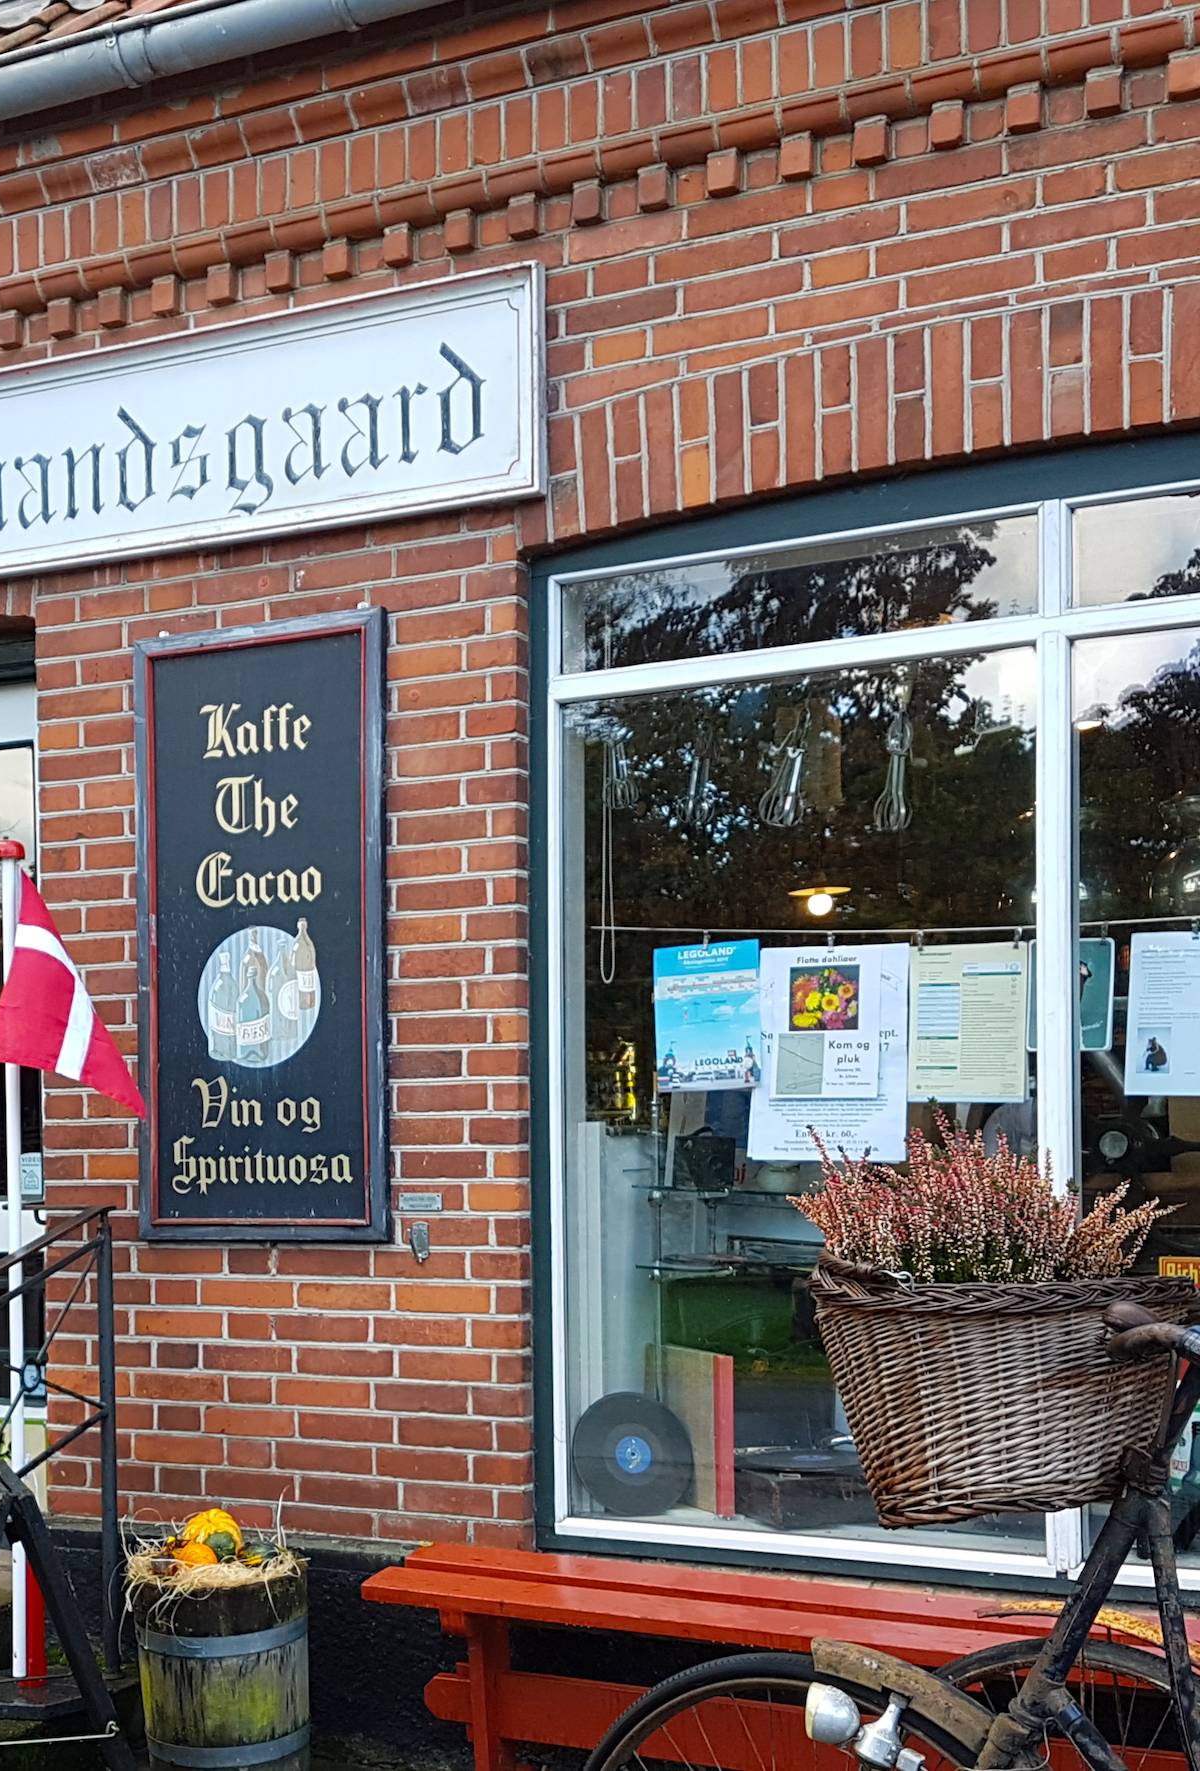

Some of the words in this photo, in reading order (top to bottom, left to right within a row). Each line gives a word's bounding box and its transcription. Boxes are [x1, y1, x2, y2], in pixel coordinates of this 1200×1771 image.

[200, 702, 312, 760] Kaffe
[214, 774, 299, 837] The
[694, 1056, 744, 1067] LEGOLAND
[828, 1040, 852, 1049] Kom
[856, 1041, 870, 1051] og
[836, 1053, 860, 1066] pluk
[192, 1076, 263, 1129] Vin
[278, 1095, 321, 1133] og
[171, 1136, 353, 1196] Spirituosa
